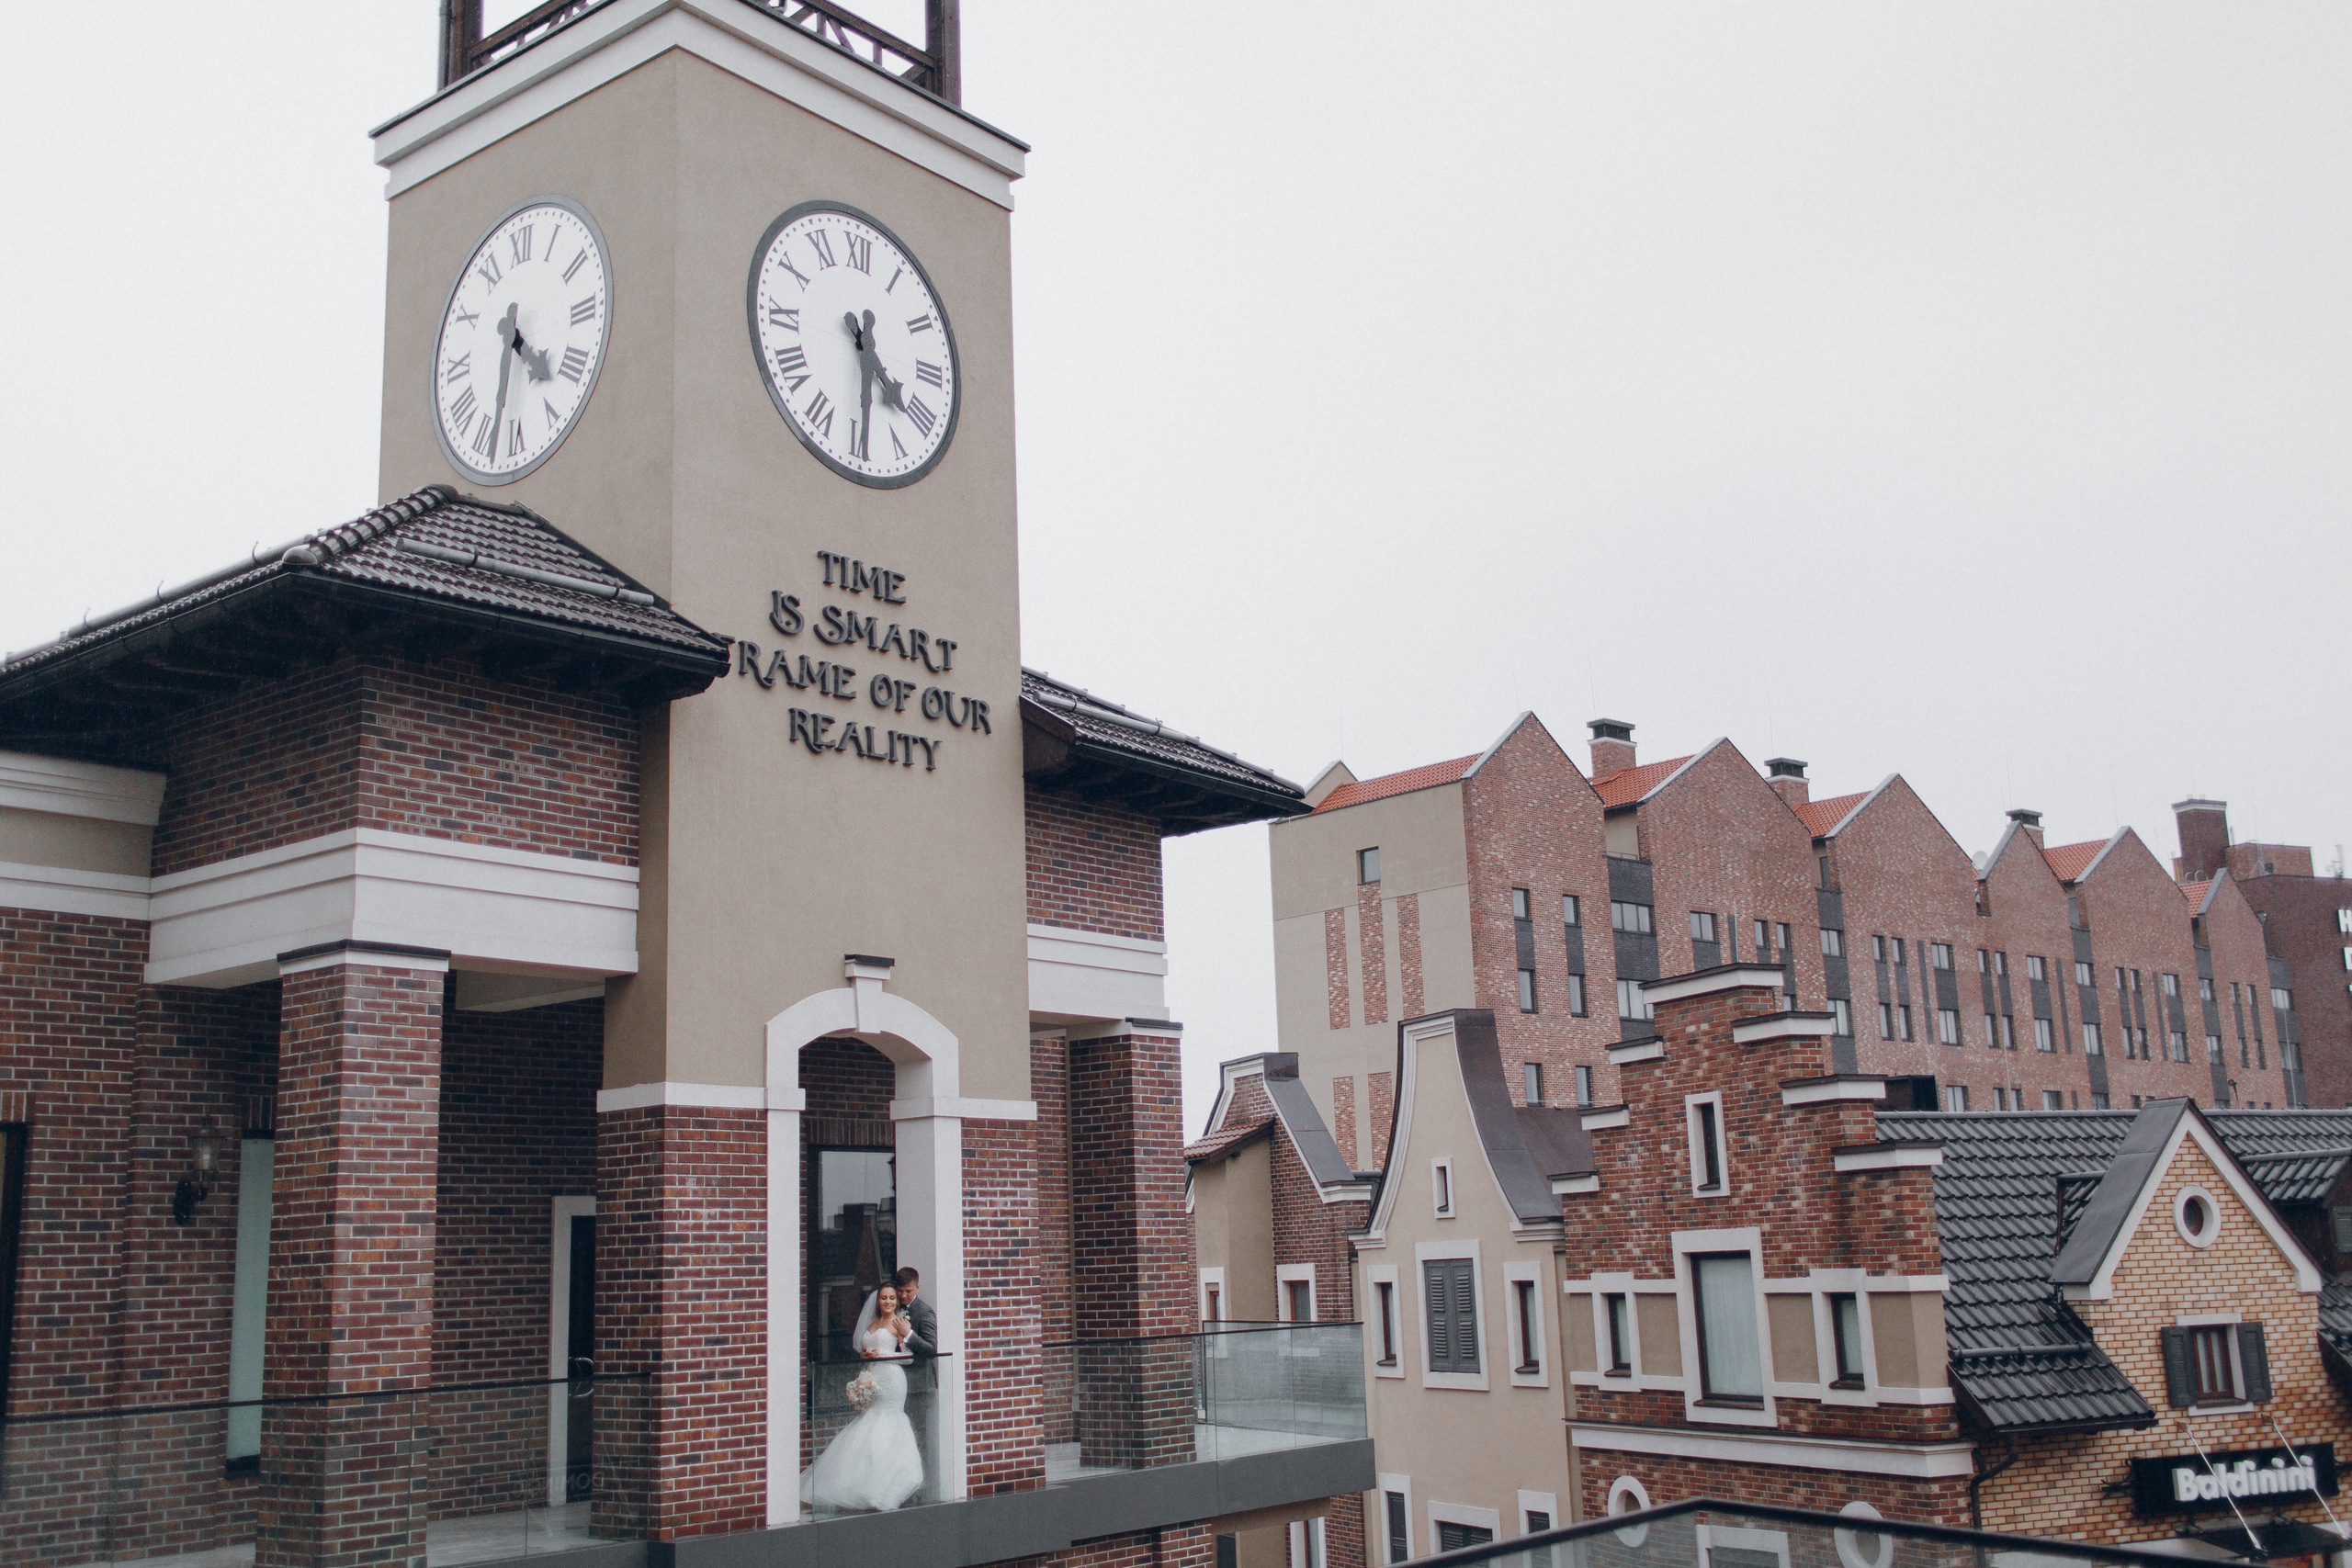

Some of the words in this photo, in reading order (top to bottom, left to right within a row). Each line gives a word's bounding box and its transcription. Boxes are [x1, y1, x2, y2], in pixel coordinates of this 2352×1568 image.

[509, 223, 534, 270] XII
[544, 223, 561, 263] I
[805, 229, 837, 271] XI
[843, 231, 873, 276] XII
[477, 251, 503, 295] XI
[561, 246, 589, 286] II
[777, 251, 810, 292] X
[885, 265, 903, 295] I
[455, 303, 480, 331] X
[570, 292, 596, 329] III
[768, 295, 799, 334] IX
[905, 311, 934, 335] II
[447, 350, 470, 387] IX
[774, 344, 813, 396] VIII
[916, 357, 943, 391] III
[450, 382, 479, 438] VIII
[543, 396, 561, 431] V
[803, 388, 835, 440] VII
[507, 416, 526, 457] VI
[888, 423, 909, 460] V
[817, 549, 907, 604] TIME
[769, 590, 805, 635] IS
[813, 604, 957, 672] SMART
[713, 632, 856, 700] RAME
[870, 673, 917, 713] OF
[922, 686, 992, 735] OUR
[788, 706, 943, 771] REALITY
[2172, 1454, 2316, 1502] Baldinini
